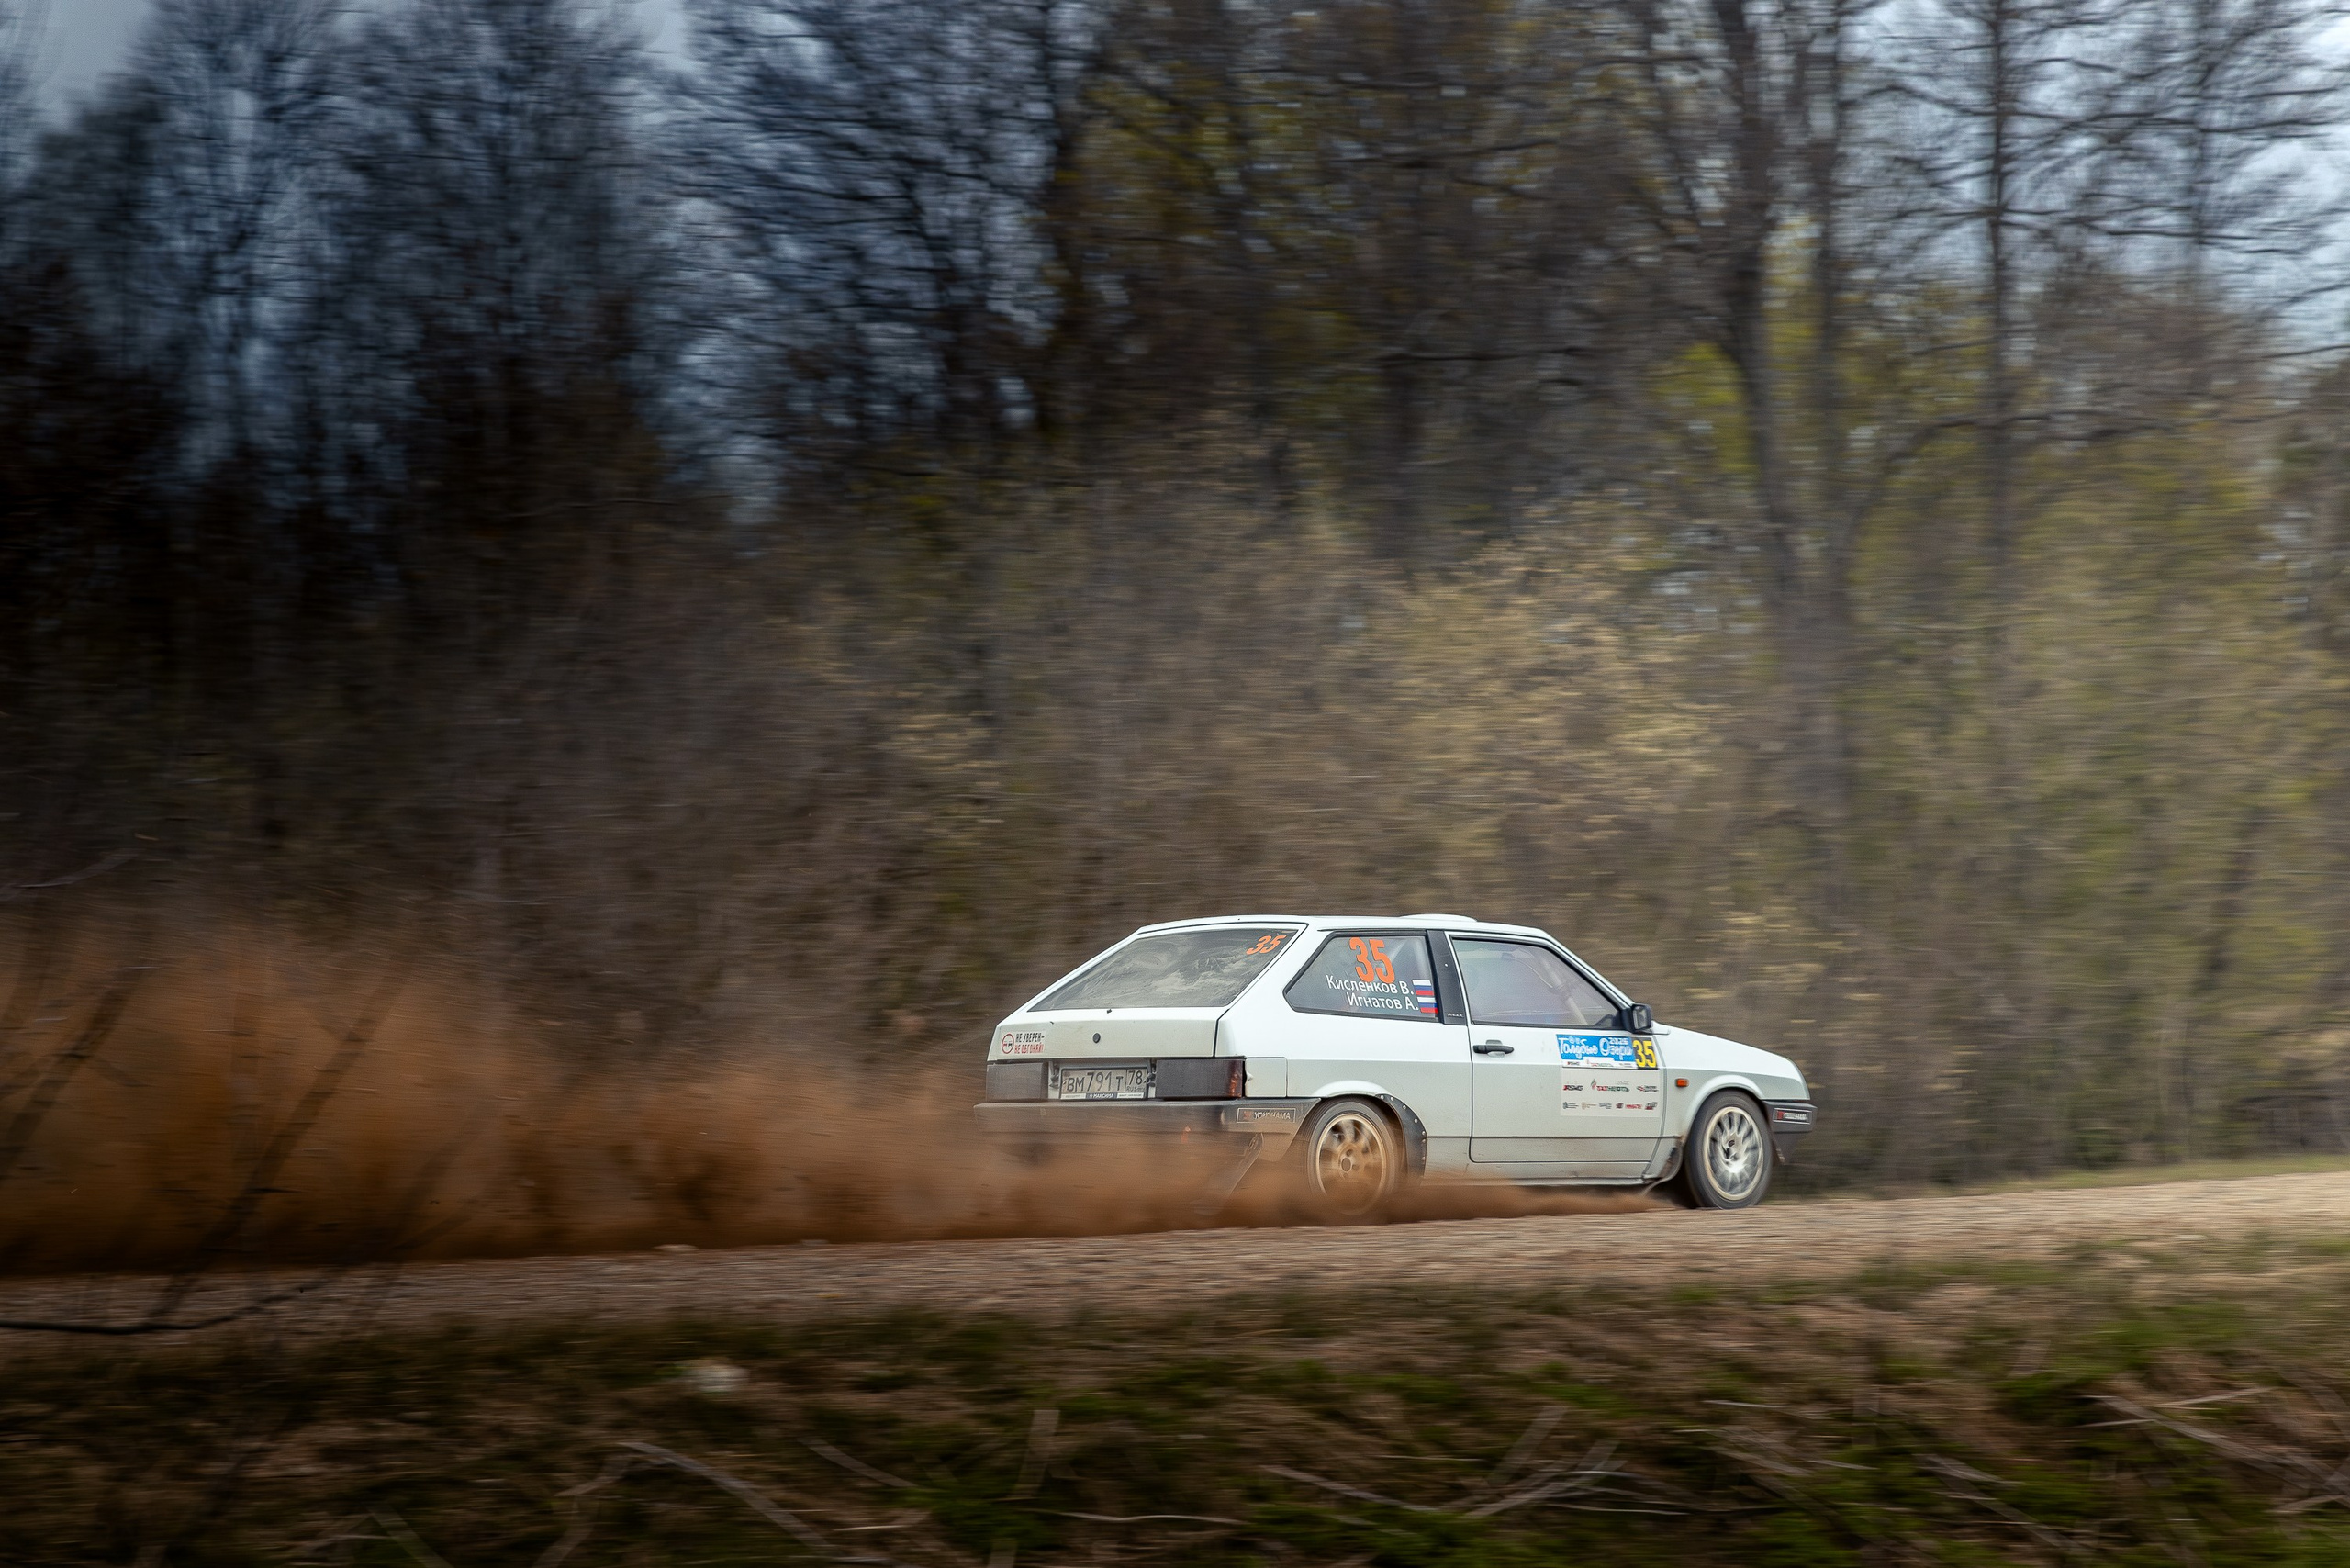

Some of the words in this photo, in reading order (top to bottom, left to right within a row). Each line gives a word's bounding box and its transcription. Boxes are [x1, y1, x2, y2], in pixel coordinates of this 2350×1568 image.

[1247, 935, 1287, 955] 35
[1349, 936, 1395, 984] 35
[1326, 975, 1397, 994] Кисленков
[1399, 980, 1415, 995] В.
[1346, 992, 1403, 1010] Игнатов
[1404, 996, 1419, 1011] А.
[1632, 1039, 1657, 1068] 35
